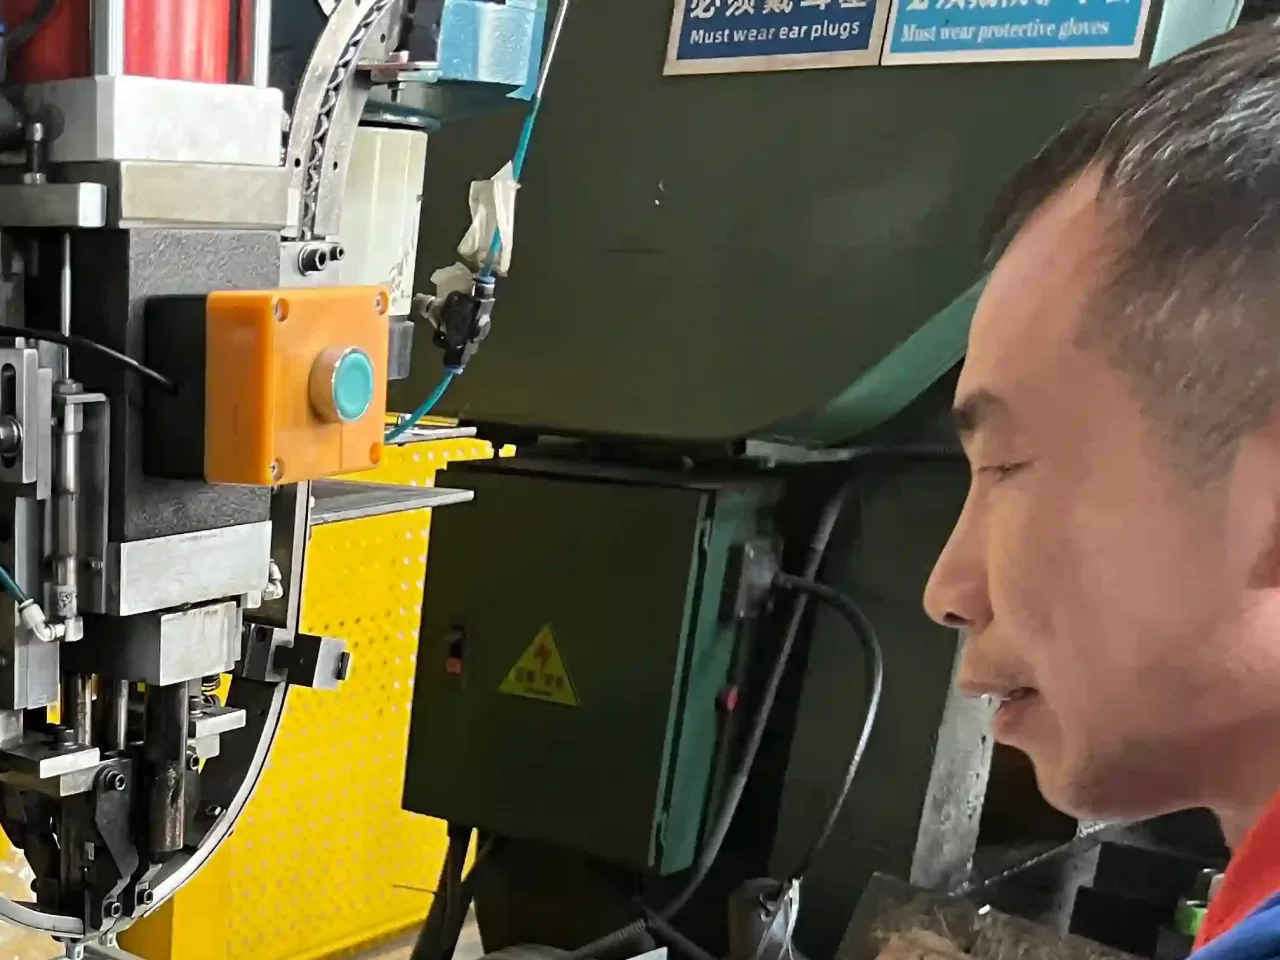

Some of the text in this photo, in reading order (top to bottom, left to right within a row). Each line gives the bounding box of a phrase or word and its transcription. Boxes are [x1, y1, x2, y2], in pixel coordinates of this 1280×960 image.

[690, 20, 860, 44] Must wear ear plugs
[901, 17, 1110, 43] Must wear protective gloves
